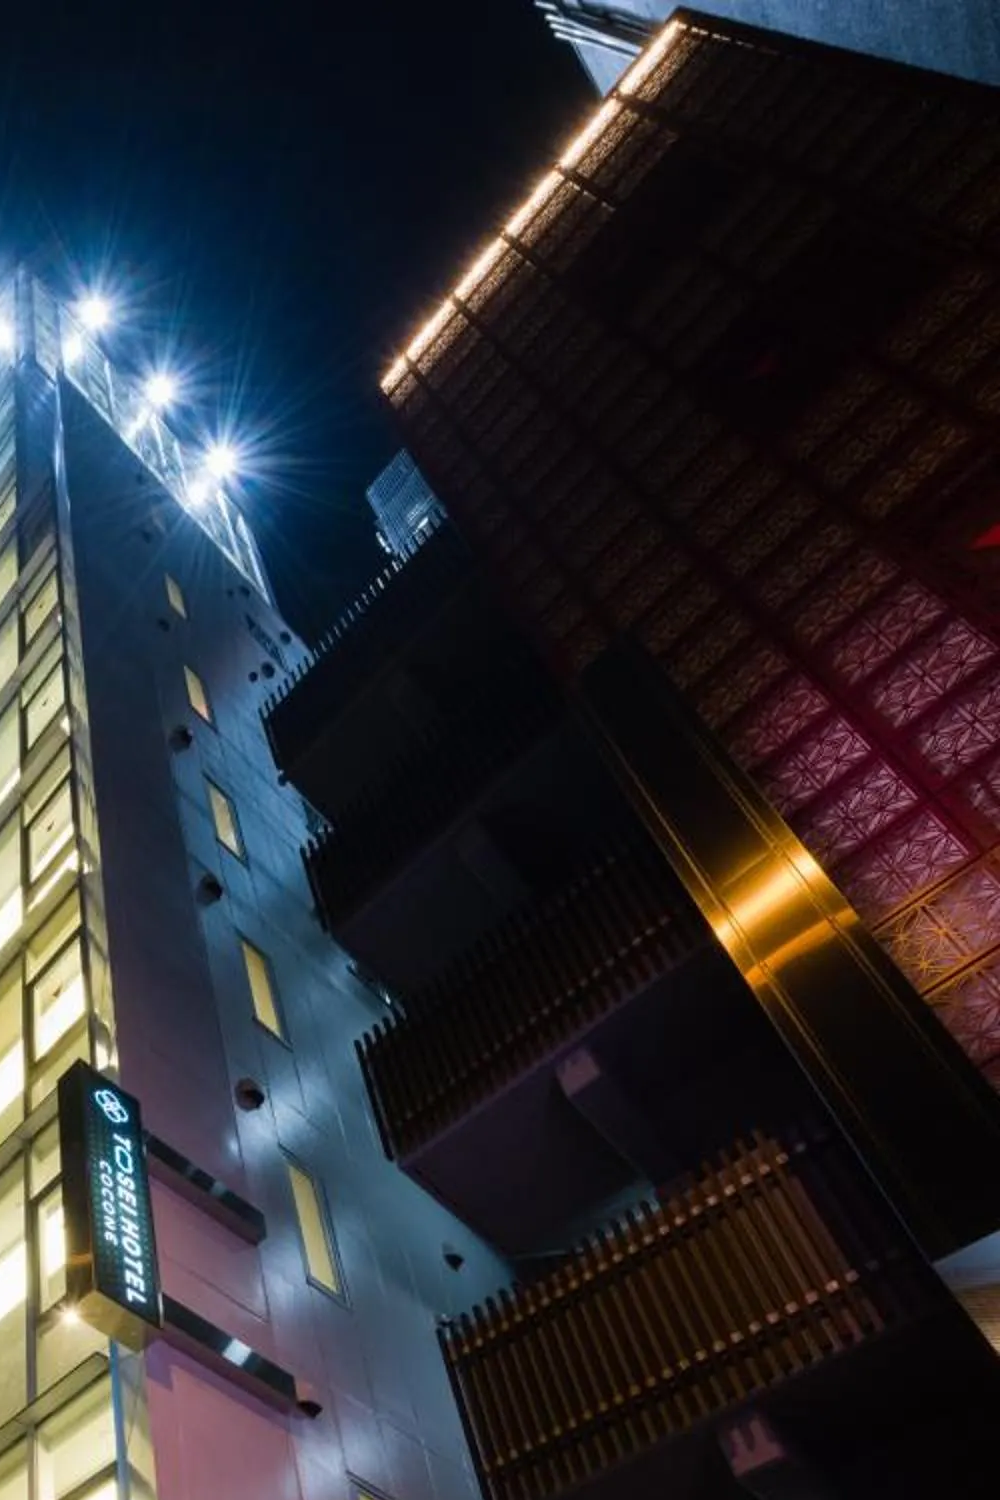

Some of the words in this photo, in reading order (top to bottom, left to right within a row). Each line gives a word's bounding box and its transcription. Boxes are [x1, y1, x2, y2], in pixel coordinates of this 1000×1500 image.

[99, 1160, 118, 1247] COCONE
[113, 1132, 139, 1217] TOSEI
[121, 1216, 147, 1304] HOTEL
